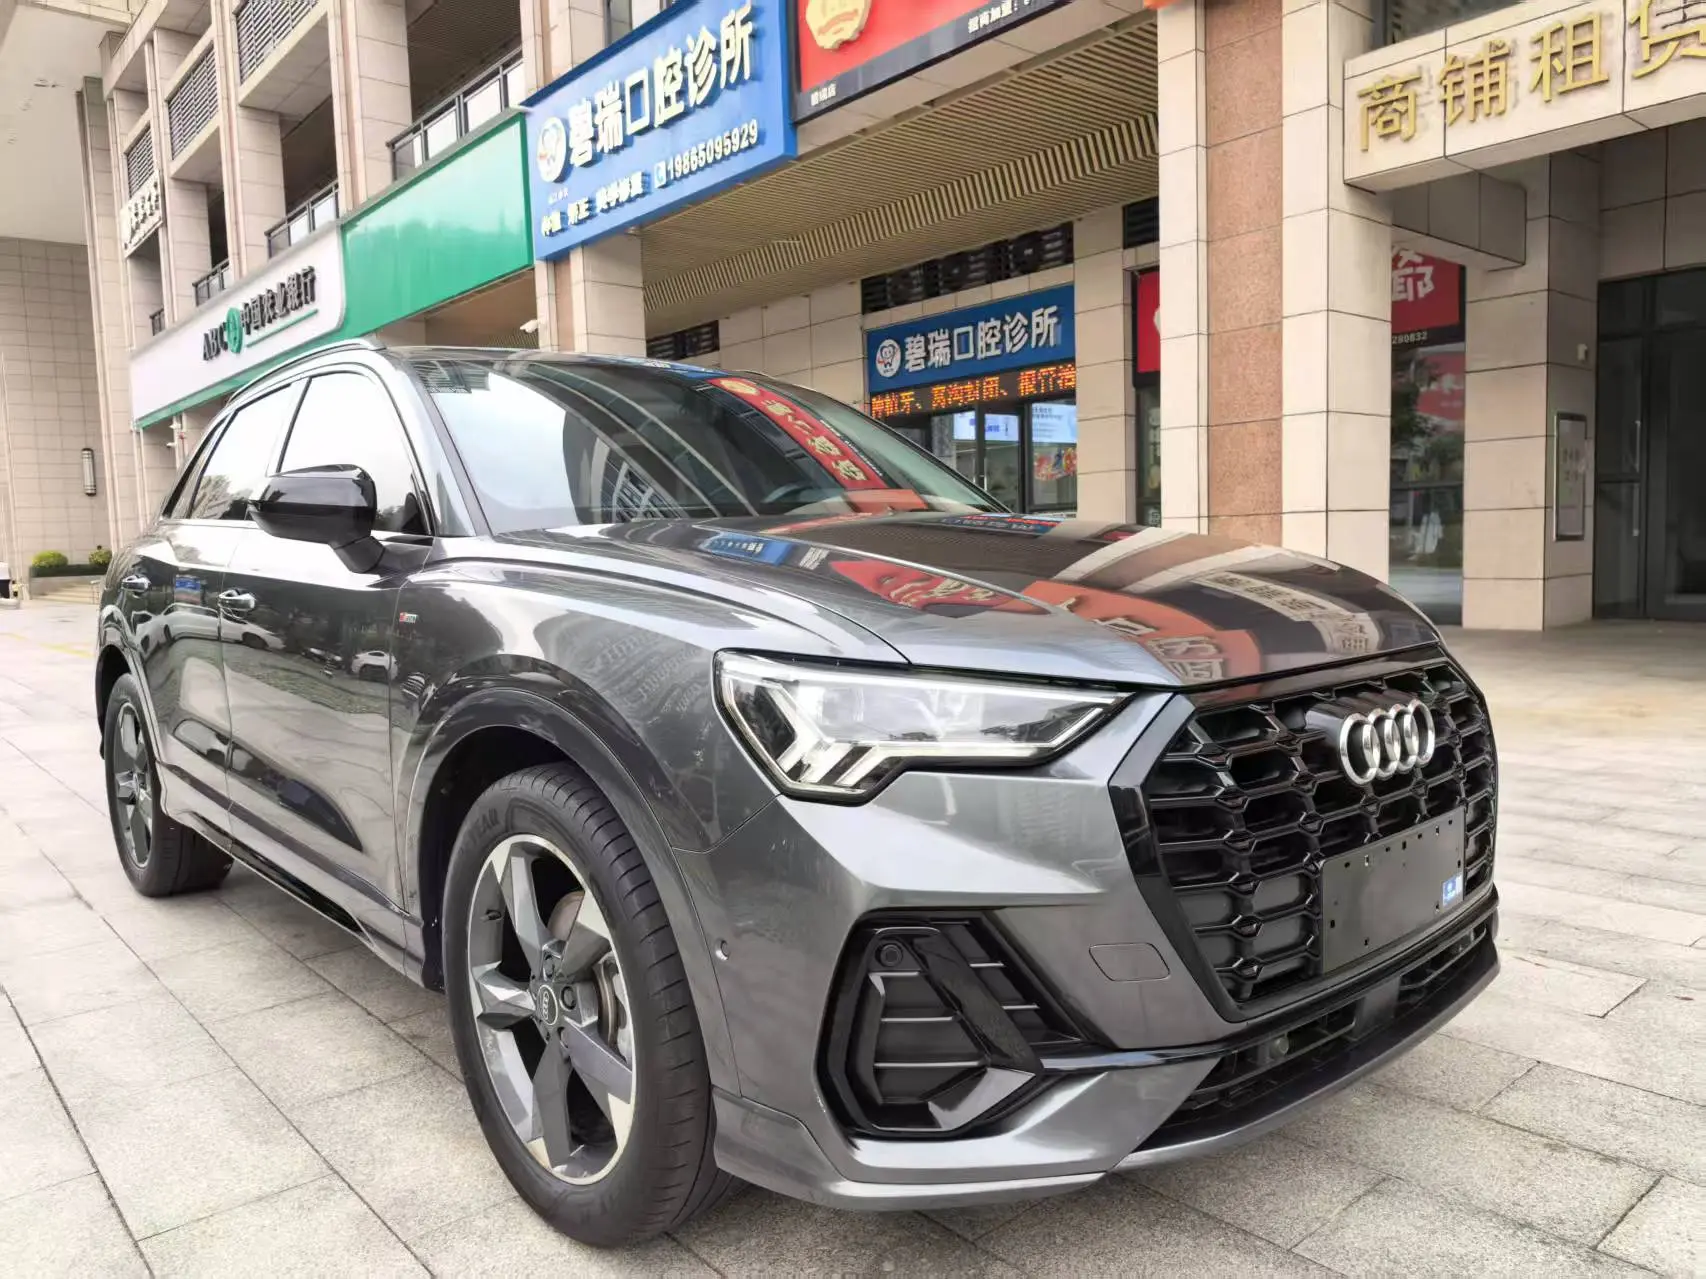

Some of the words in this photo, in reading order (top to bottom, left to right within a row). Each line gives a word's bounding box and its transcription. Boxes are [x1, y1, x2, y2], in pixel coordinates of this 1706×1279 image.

[568, 0, 753, 167] 碧瑞口腔诊所
[667, 118, 758, 180] 19865095929
[240, 265, 316, 336] 中国农业银行
[203, 322, 228, 361] ABC
[904, 305, 1058, 373] 碧瑞口腔诊所
